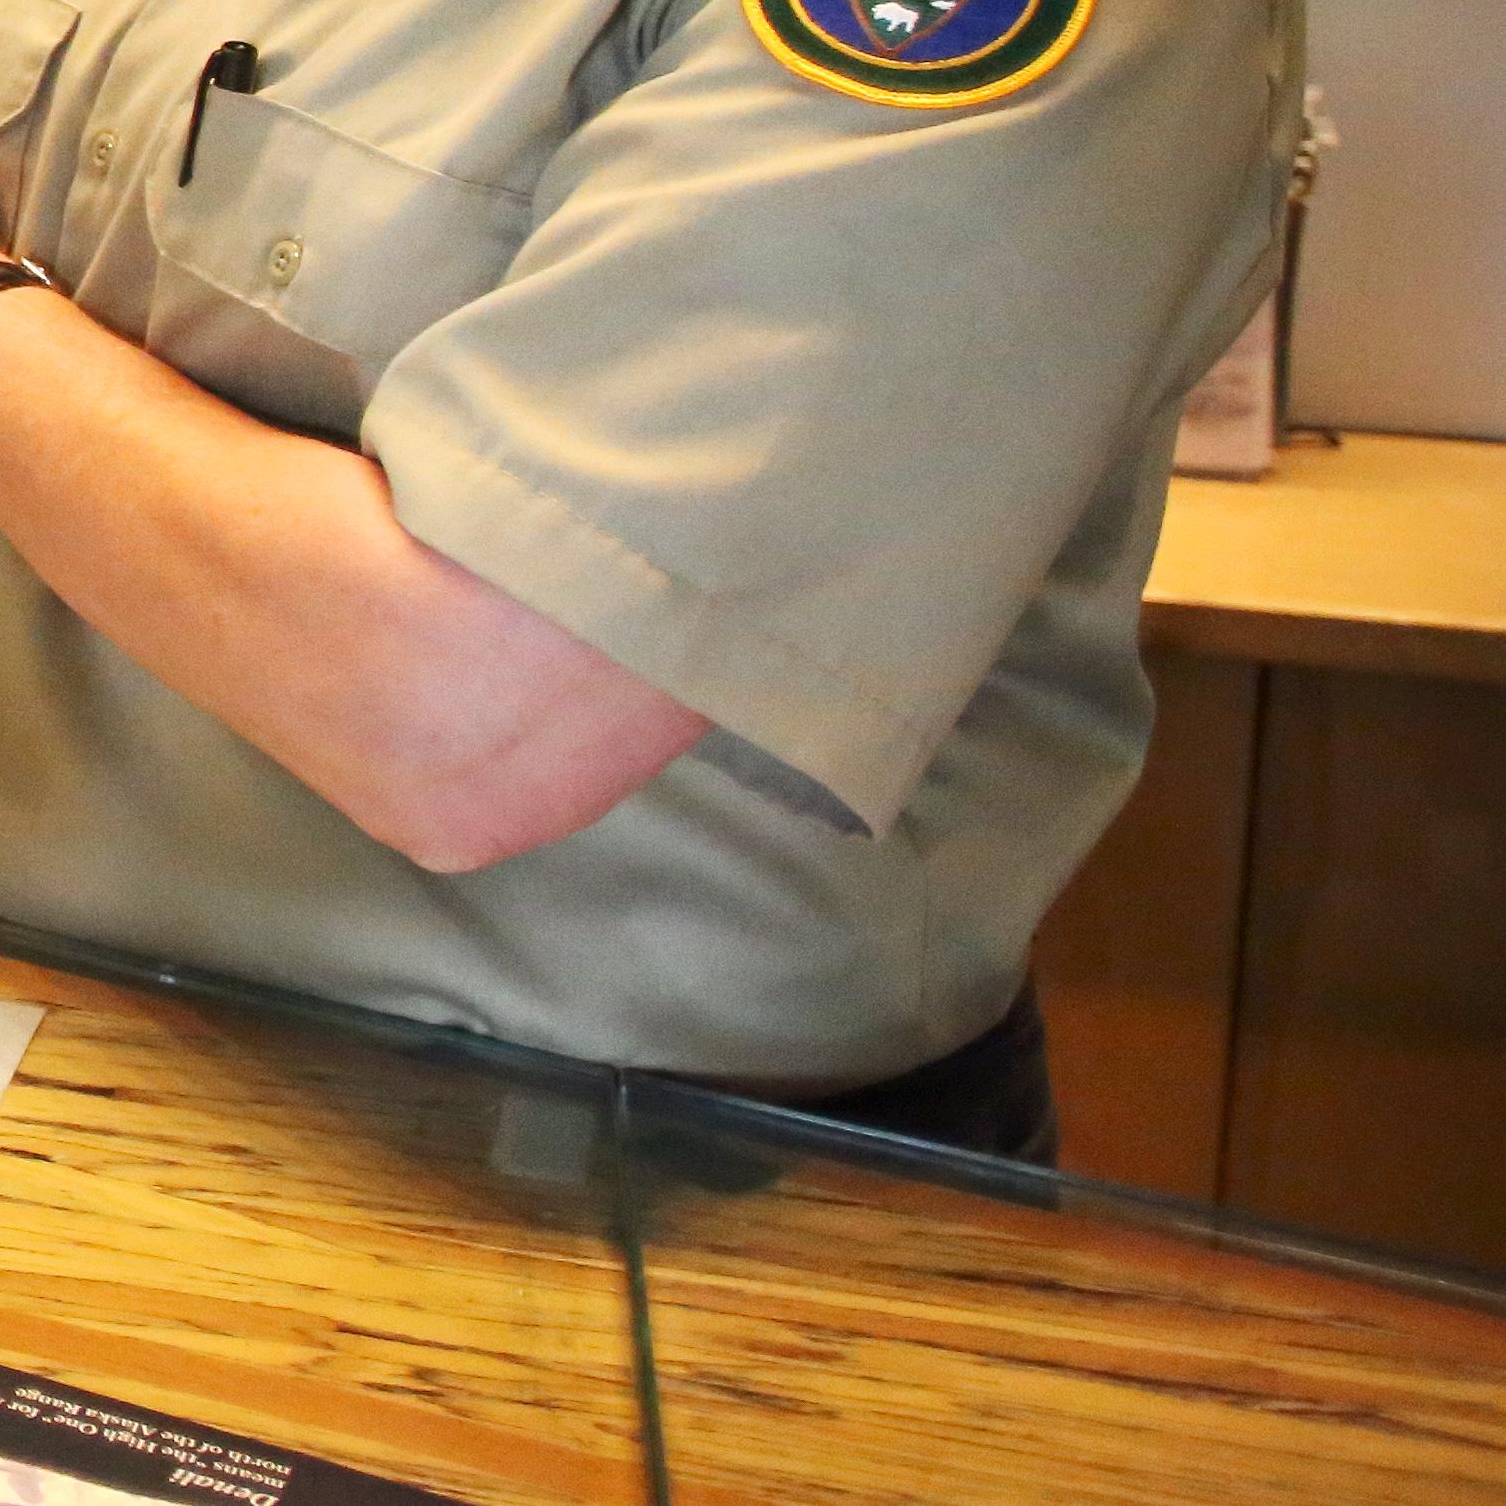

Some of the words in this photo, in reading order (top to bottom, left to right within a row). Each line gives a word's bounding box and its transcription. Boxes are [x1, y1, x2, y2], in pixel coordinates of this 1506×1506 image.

[7, 1403, 41, 1419] for
[14, 1387, 82, 1416] Range
[85, 1408, 159, 1437] Alaska
[103, 1428, 157, 1455] High
[159, 1431, 196, 1449] the
[196, 1441, 224, 1456] of
[212, 1460, 286, 1490] means
[228, 1449, 293, 1475] north
[169, 1468, 280, 1506] Denali
